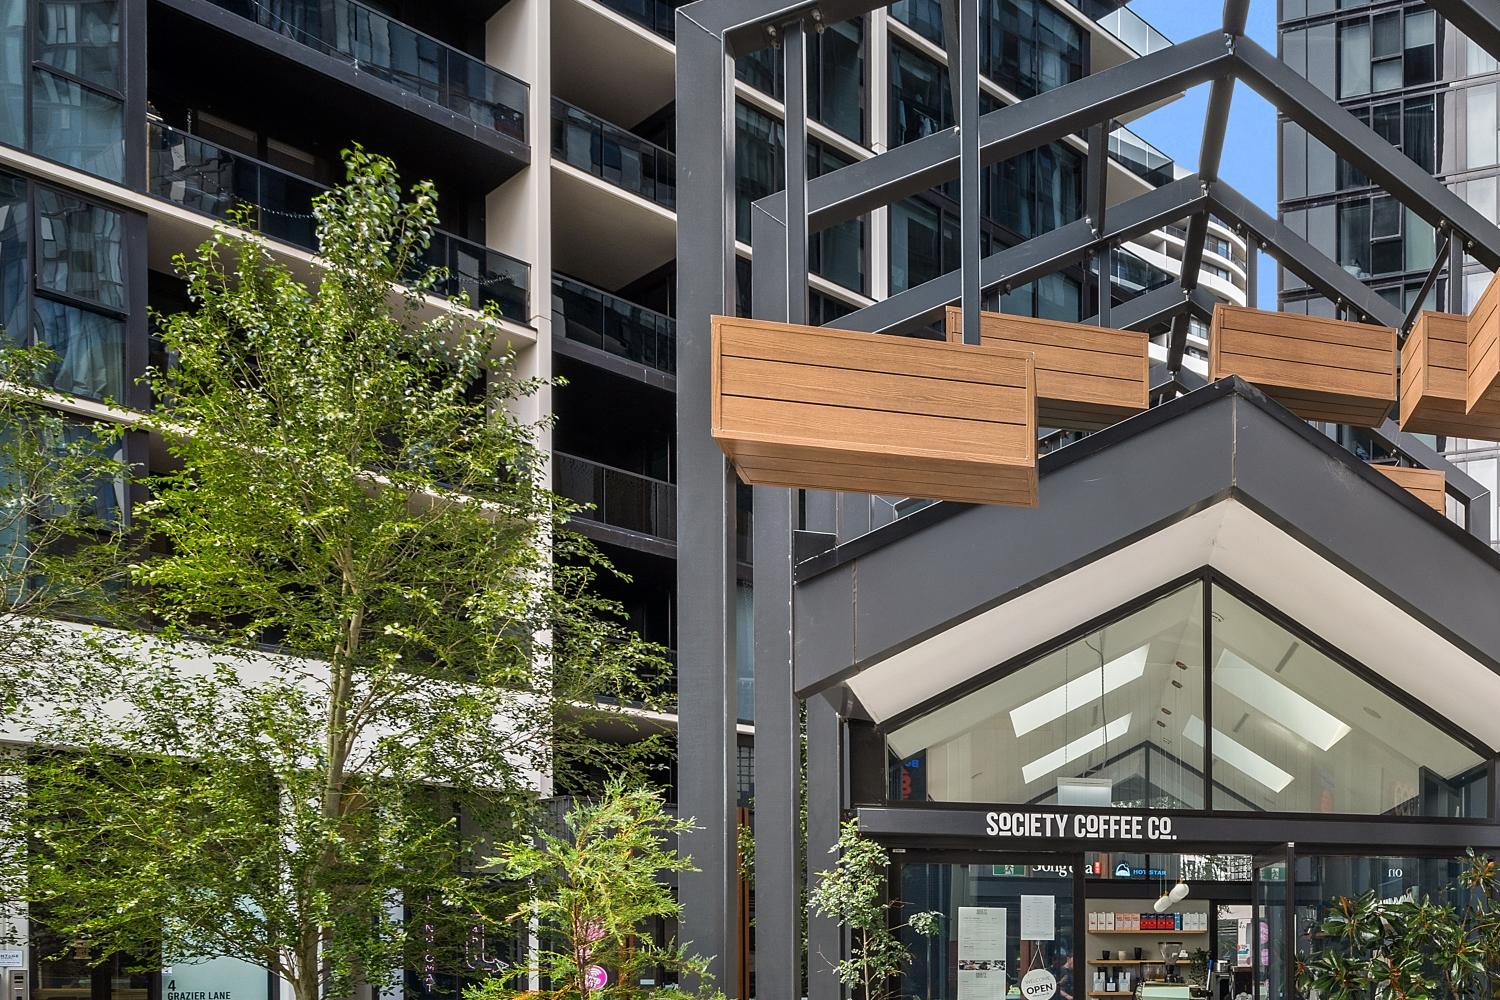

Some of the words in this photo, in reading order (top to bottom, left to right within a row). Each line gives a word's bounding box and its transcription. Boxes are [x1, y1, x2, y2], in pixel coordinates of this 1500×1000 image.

[986, 811, 1068, 837] SOCIETY
[1073, 814, 1142, 839] COFFEE
[1147, 816, 1177, 840] CO.
[168, 980, 176, 991] 4
[1027, 983, 1053, 995] OPEN
[168, 991, 205, 1000] GRAZIER
[208, 991, 231, 1000] LANE
